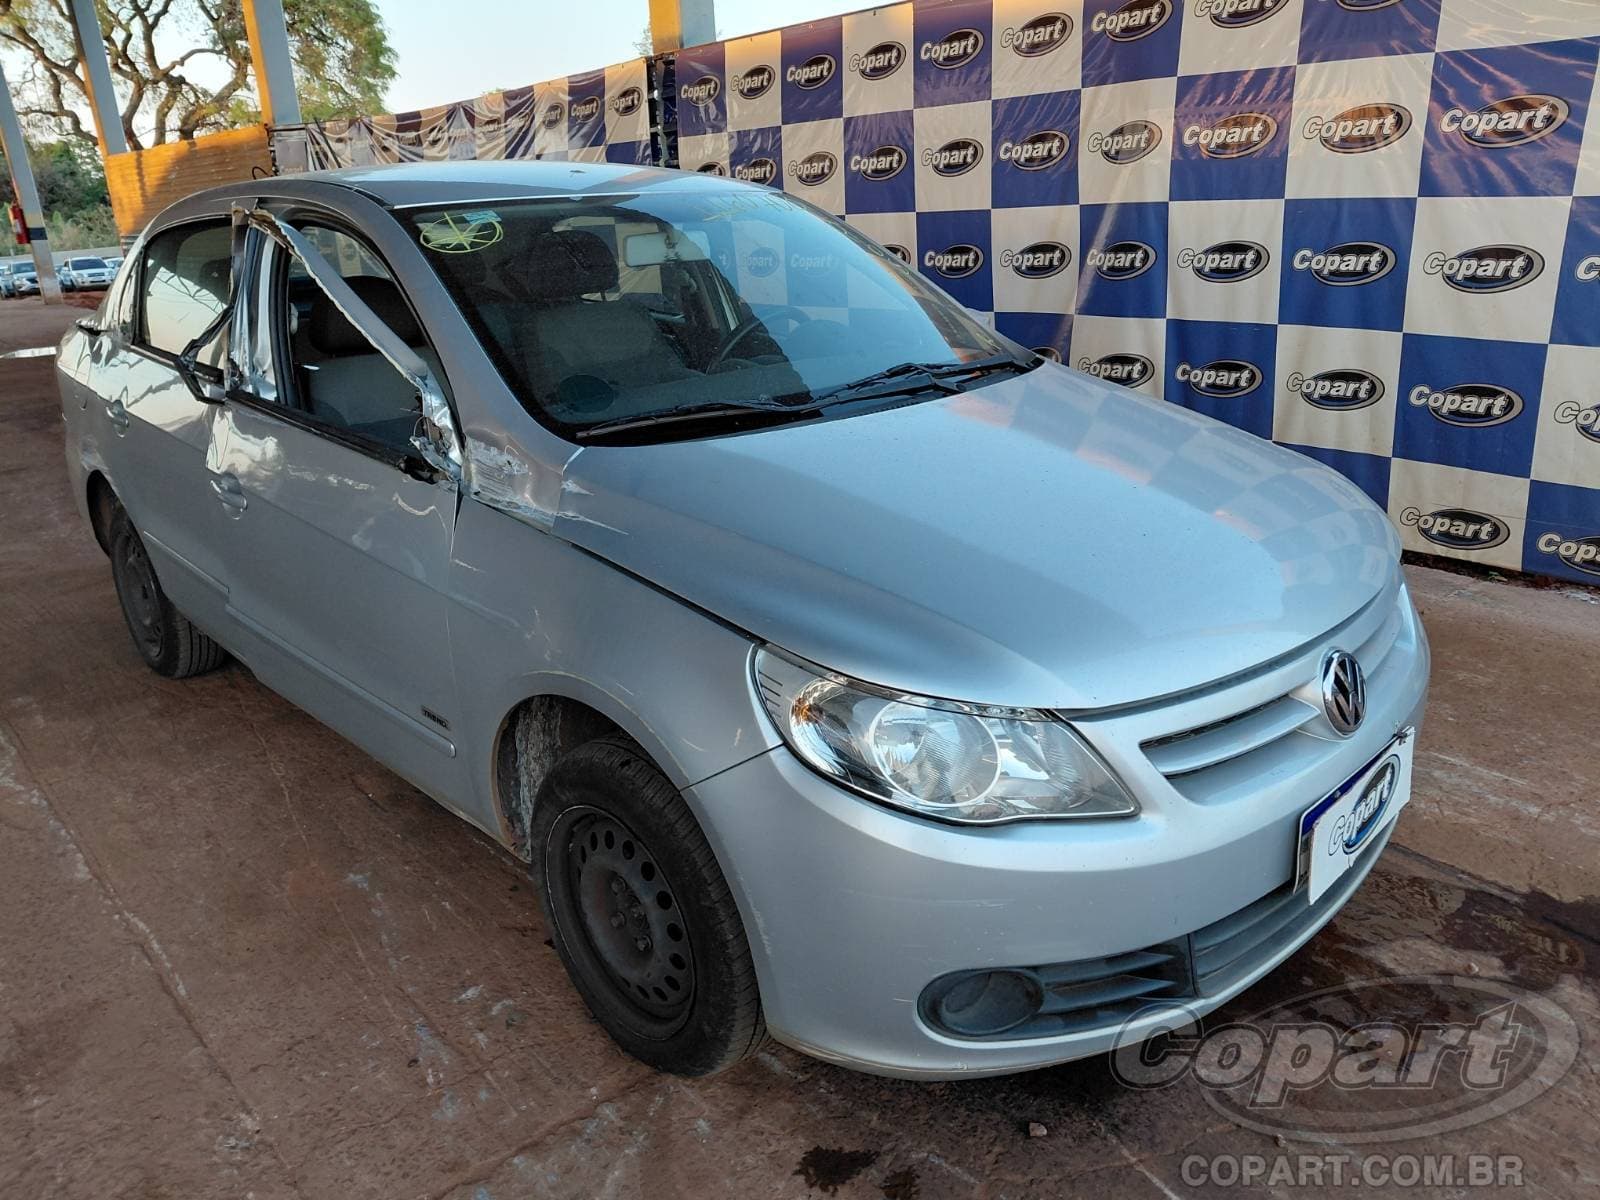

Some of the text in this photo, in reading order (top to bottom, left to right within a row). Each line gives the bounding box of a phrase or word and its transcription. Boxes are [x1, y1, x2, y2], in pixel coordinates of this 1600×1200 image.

[1001, 18, 1063, 49] Copart
[1091, 4, 1162, 35] Copart
[849, 45, 900, 74] Copart
[920, 32, 977, 62] Copart
[731, 70, 770, 93] Copart
[786, 59, 832, 85] Copart
[681, 80, 717, 101] Copart
[571, 102, 598, 117] Copart
[1440, 102, 1552, 138] Copart
[1088, 126, 1151, 154] Copart
[1183, 119, 1265, 150] Copart
[1302, 109, 1399, 143] Copart
[850, 149, 901, 176] Copart
[921, 142, 976, 171] Copart
[999, 136, 1062, 164] Copart
[735, 163, 771, 181] Copart
[788, 156, 832, 182] Copart
[924, 247, 977, 270] Copart
[1000, 246, 1063, 270] Copart
[1087, 246, 1145, 270] Copart
[1176, 246, 1259, 273] Copart
[1293, 247, 1384, 277] Copart
[1423, 251, 1530, 282] Copart
[1078, 357, 1142, 379] Copart
[1175, 362, 1253, 388] Copart
[1286, 371, 1374, 400] Copart
[1409, 384, 1510, 418] Copart
[1400, 507, 1497, 541] Copart
[1328, 762, 1393, 856] Copart
